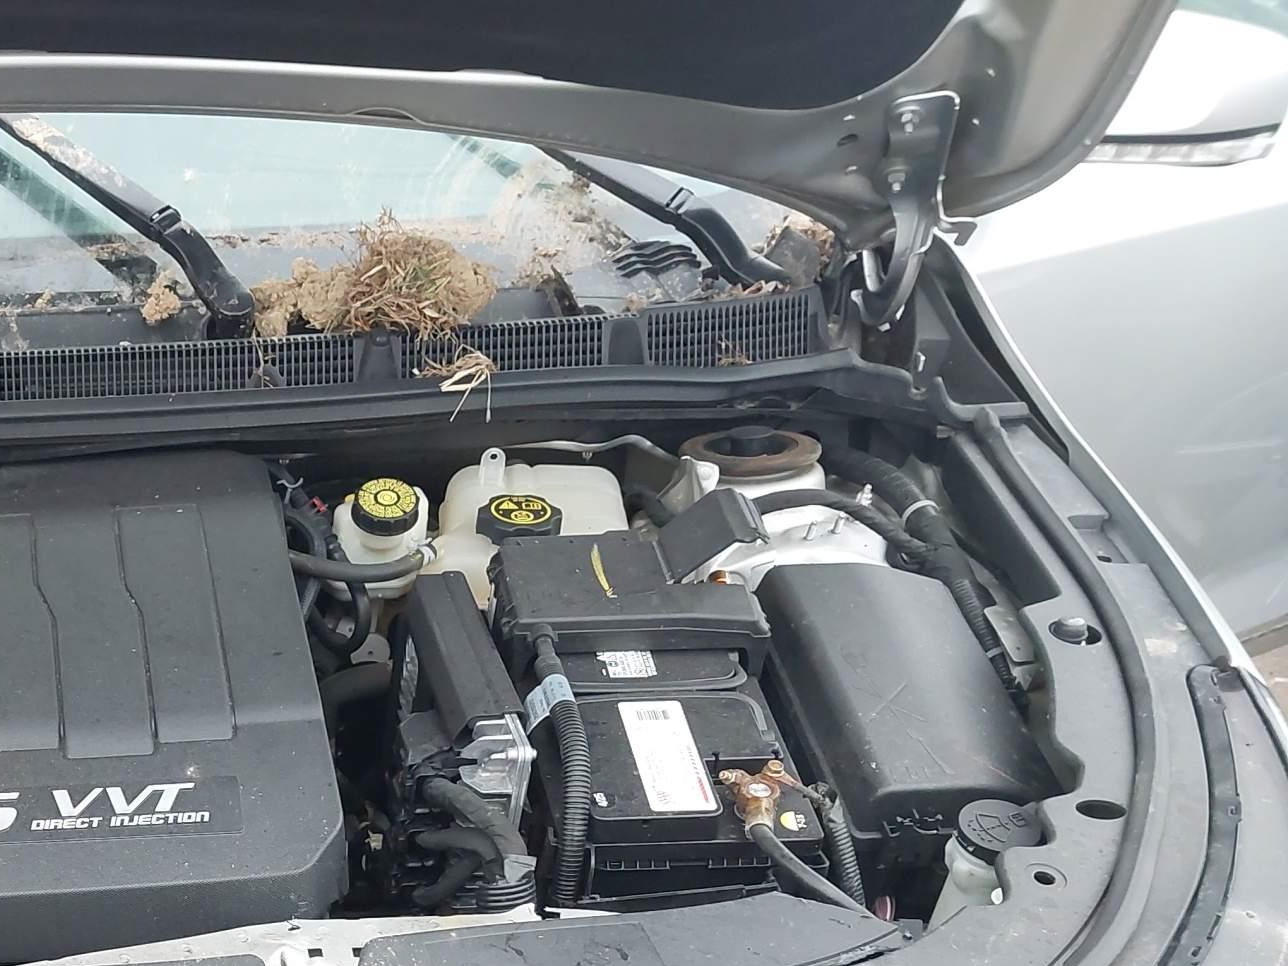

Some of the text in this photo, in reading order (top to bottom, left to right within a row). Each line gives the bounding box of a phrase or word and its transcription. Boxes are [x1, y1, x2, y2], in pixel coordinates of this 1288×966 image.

[52, 782, 196, 816] VVT
[30, 811, 211, 831] DIRECT INJECTION
